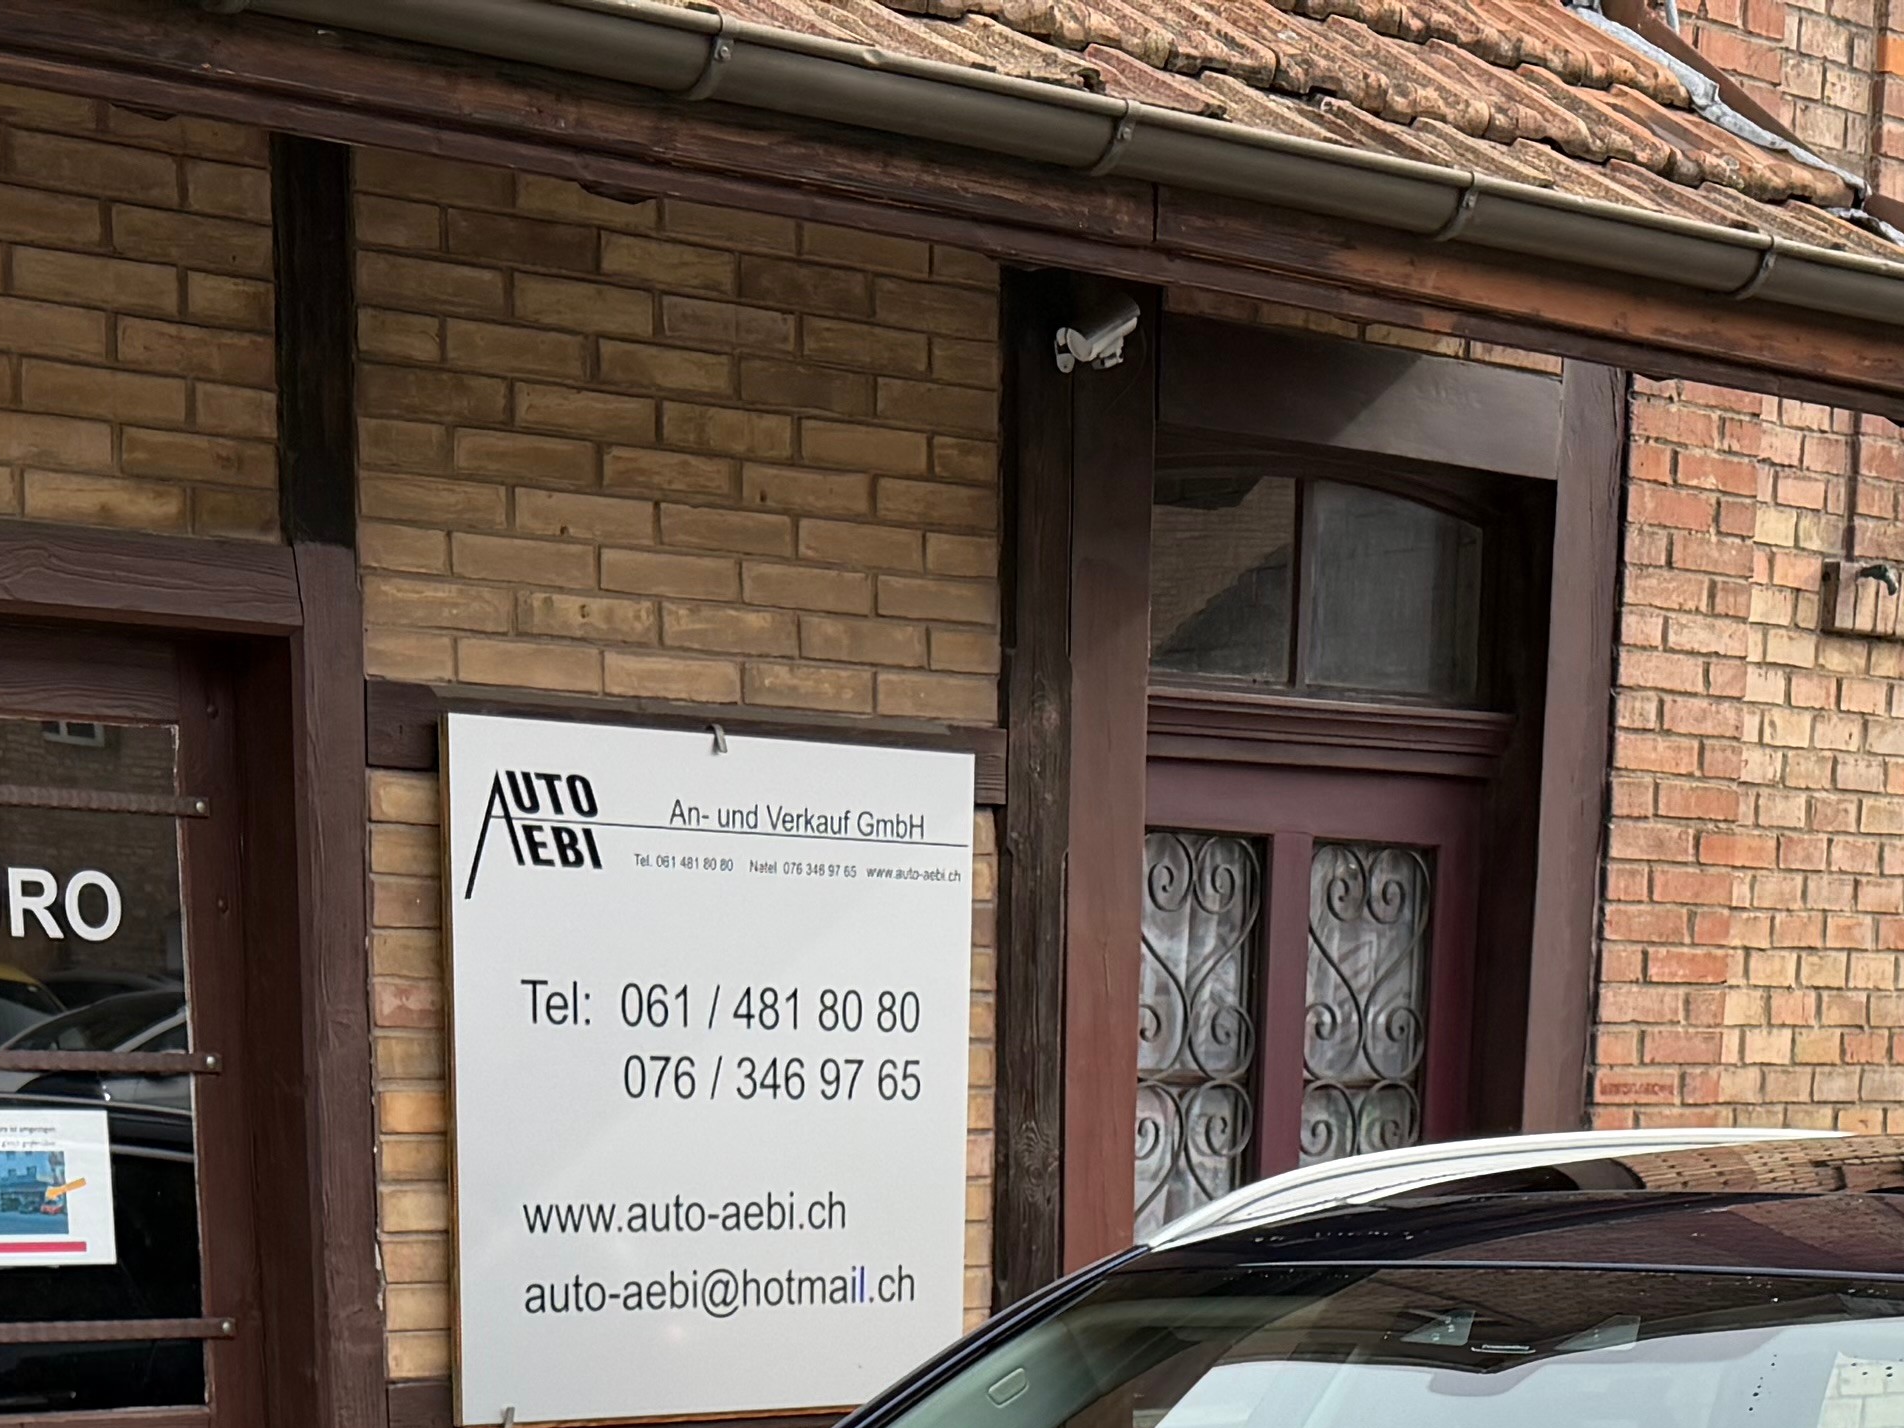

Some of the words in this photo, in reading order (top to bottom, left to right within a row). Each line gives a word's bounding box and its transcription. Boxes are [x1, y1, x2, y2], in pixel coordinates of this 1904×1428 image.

[669, 799, 710, 826] An-
[717, 804, 759, 829] und
[767, 805, 852, 835] Verkauf
[857, 811, 925, 840] GmbH
[702, 858, 717, 871] 80
[719, 859, 734, 872] 80
[783, 862, 803, 875] 076
[827, 865, 841, 878] 97
[521, 979, 591, 1026] Tel:
[621, 983, 688, 1028] 061
[708, 984, 721, 1029] /
[733, 987, 799, 1031] 481
[818, 989, 863, 1032] 80
[877, 991, 921, 1034] 80
[624, 1055, 696, 1099] 076
[710, 1055, 723, 1099] /
[736, 1057, 805, 1101] 346
[820, 1058, 865, 1101] 97
[878, 1059, 921, 1102] 65
[523, 1190, 846, 1235] www.auto-aebi.ch
[524, 1264, 915, 1319] auto-aebi@hotmail.ch
